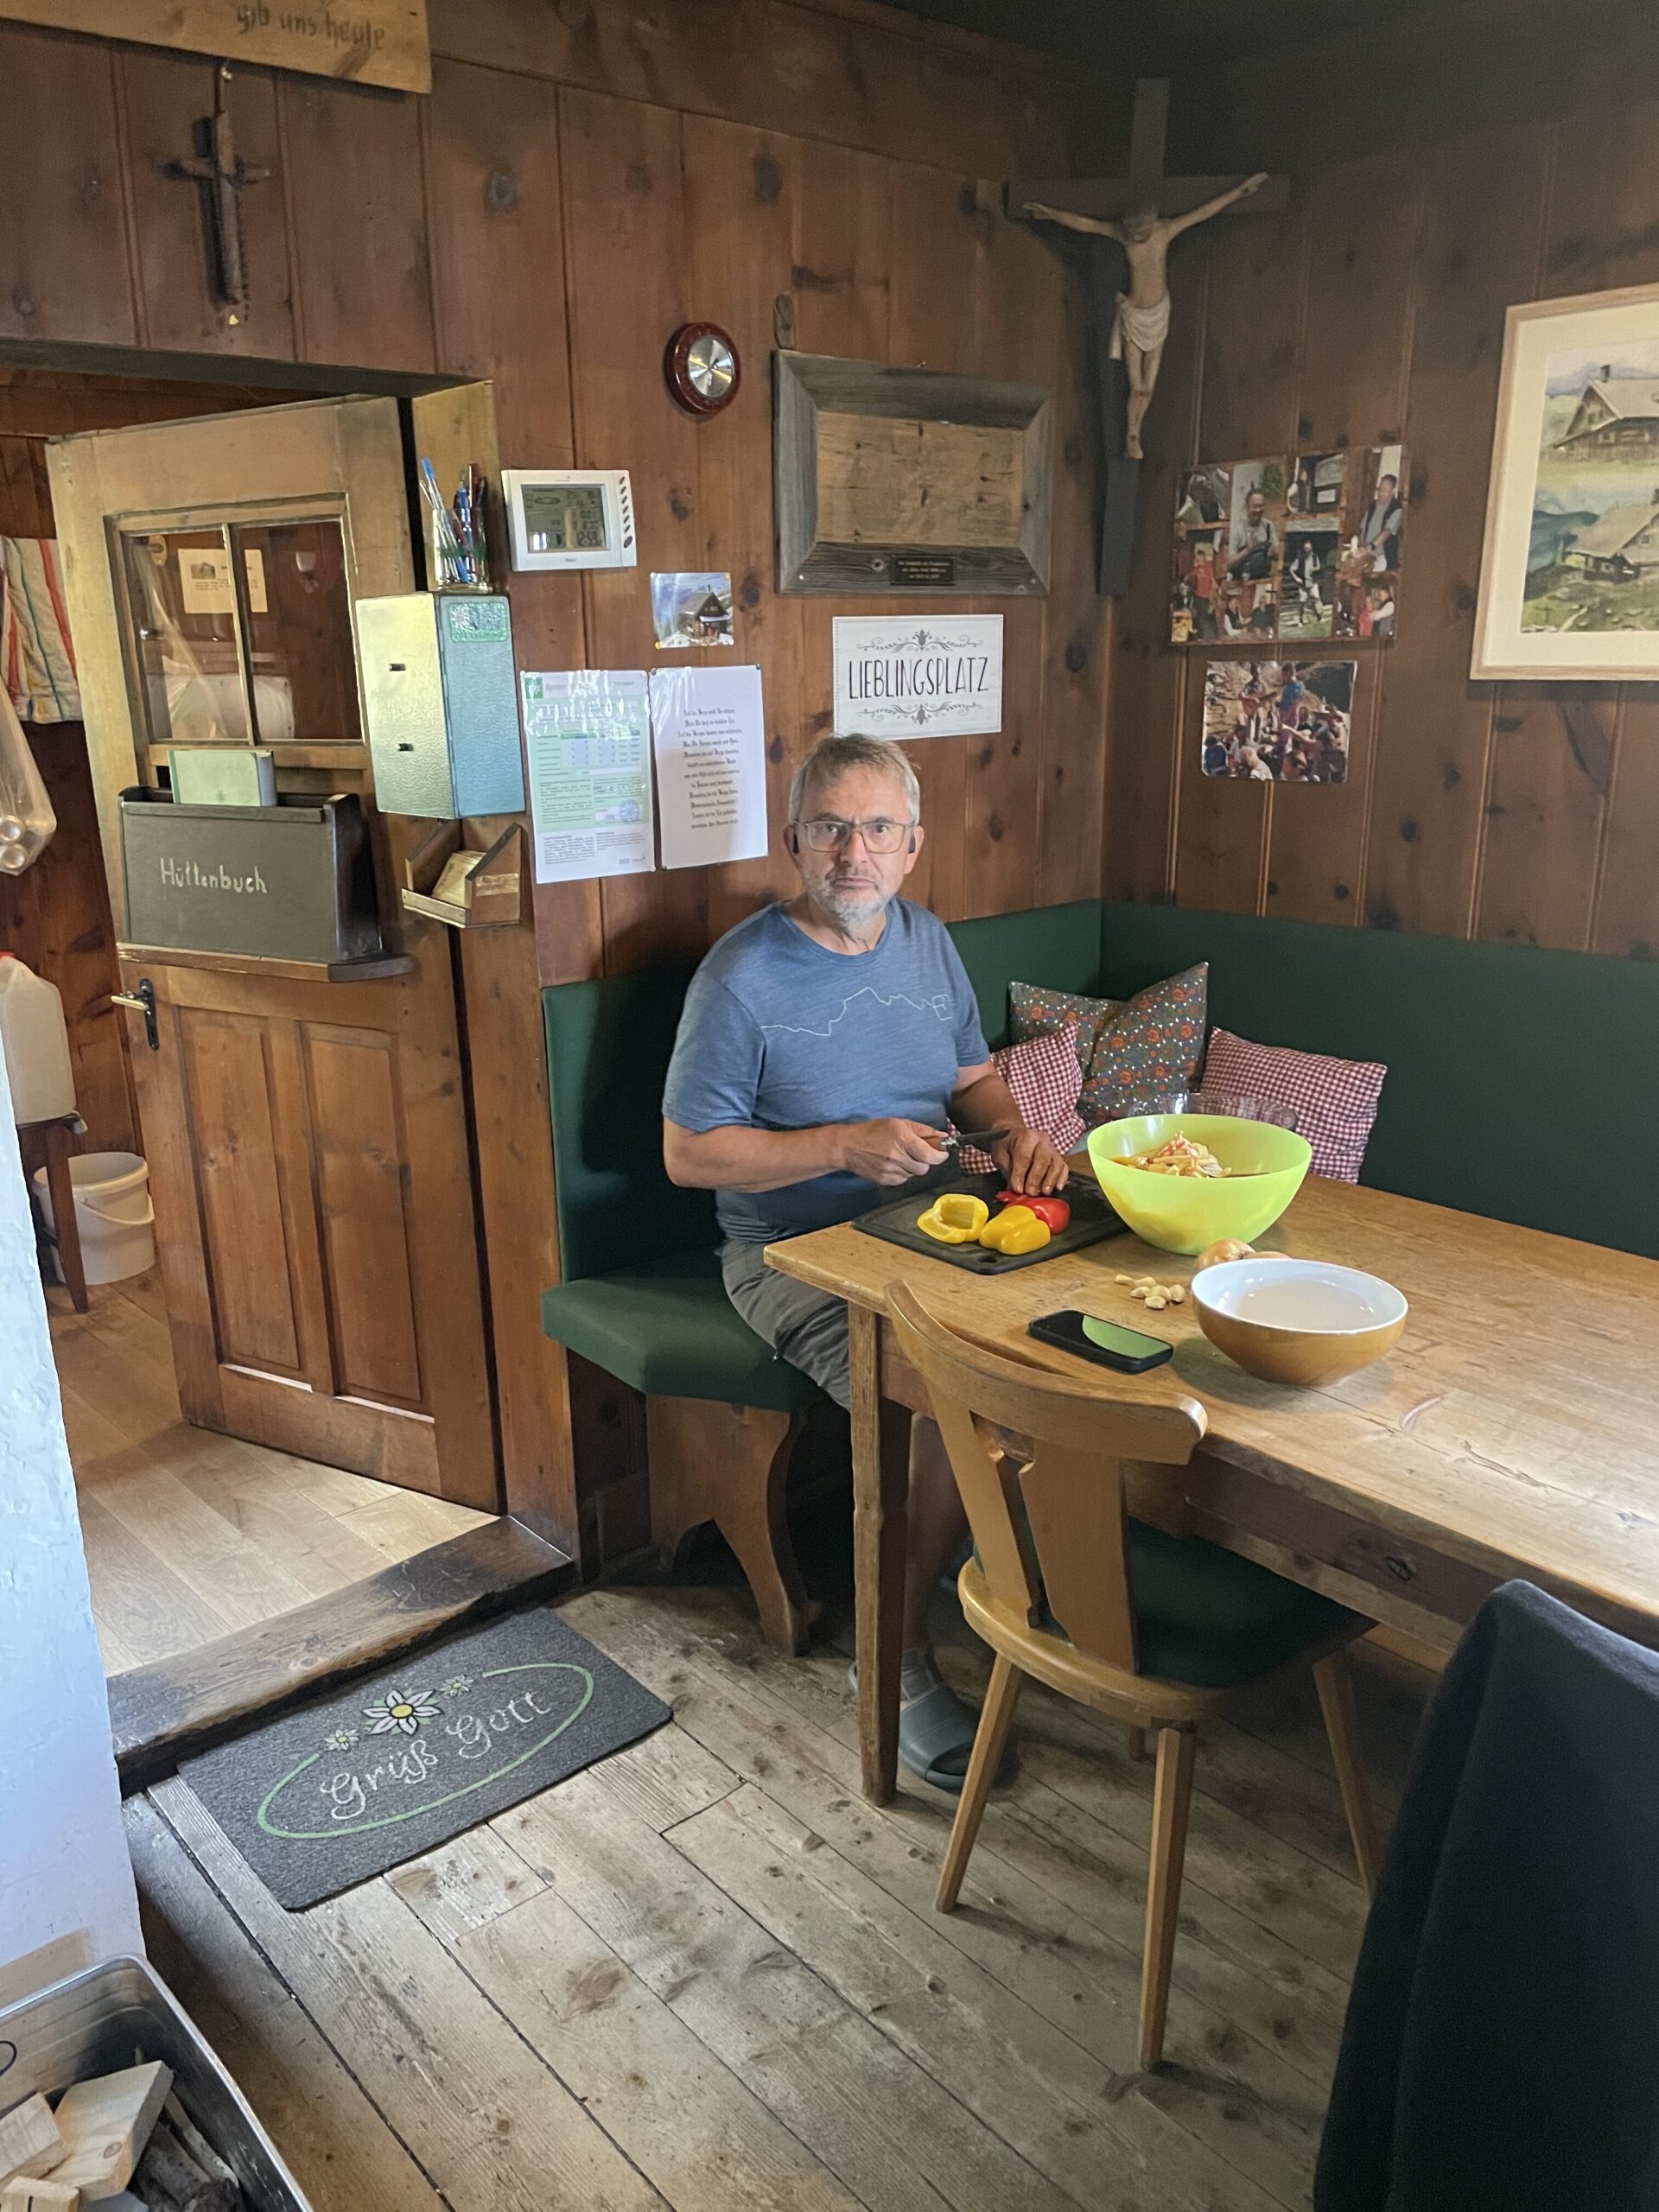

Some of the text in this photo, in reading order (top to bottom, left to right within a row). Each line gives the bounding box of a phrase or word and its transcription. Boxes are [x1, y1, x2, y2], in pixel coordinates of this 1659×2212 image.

[237, 3, 270, 34] gib
[279, 13, 317, 36] uns
[849, 657, 989, 699] LIEBLINGSPLATZ
[160, 857, 268, 893] Hüttenbuch
[320, 1691, 551, 1820] Grüß Gott
